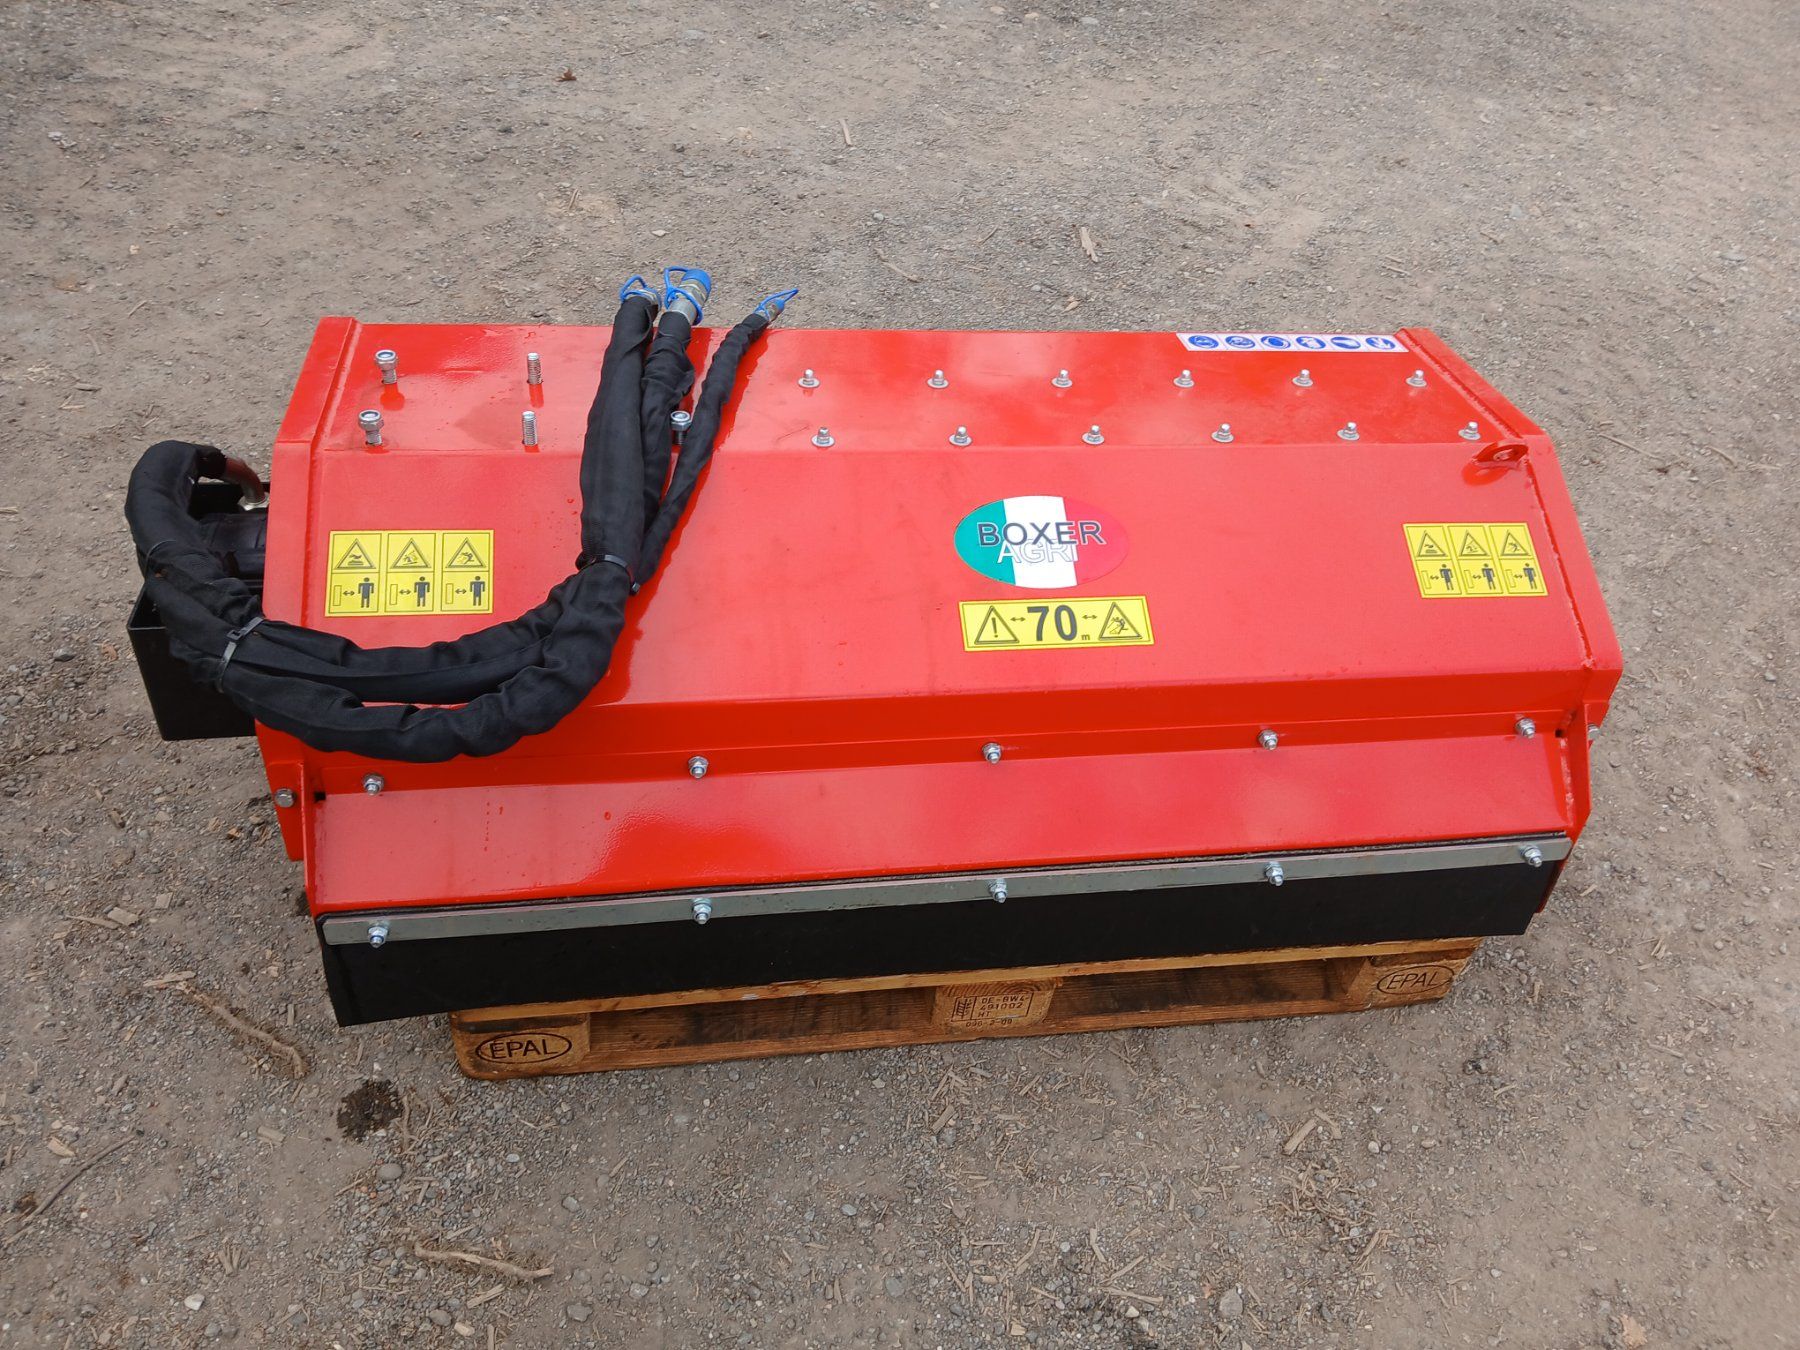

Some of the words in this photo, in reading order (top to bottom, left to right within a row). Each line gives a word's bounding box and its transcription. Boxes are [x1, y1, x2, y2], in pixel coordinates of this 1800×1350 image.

[977, 521, 1107, 548] BOXER
[997, 538, 1079, 564] AGRI
[1027, 604, 1078, 642] 70
[1081, 632, 1090, 641] m
[1386, 971, 1439, 990] EPAL
[489, 1039, 559, 1059] EPAL
